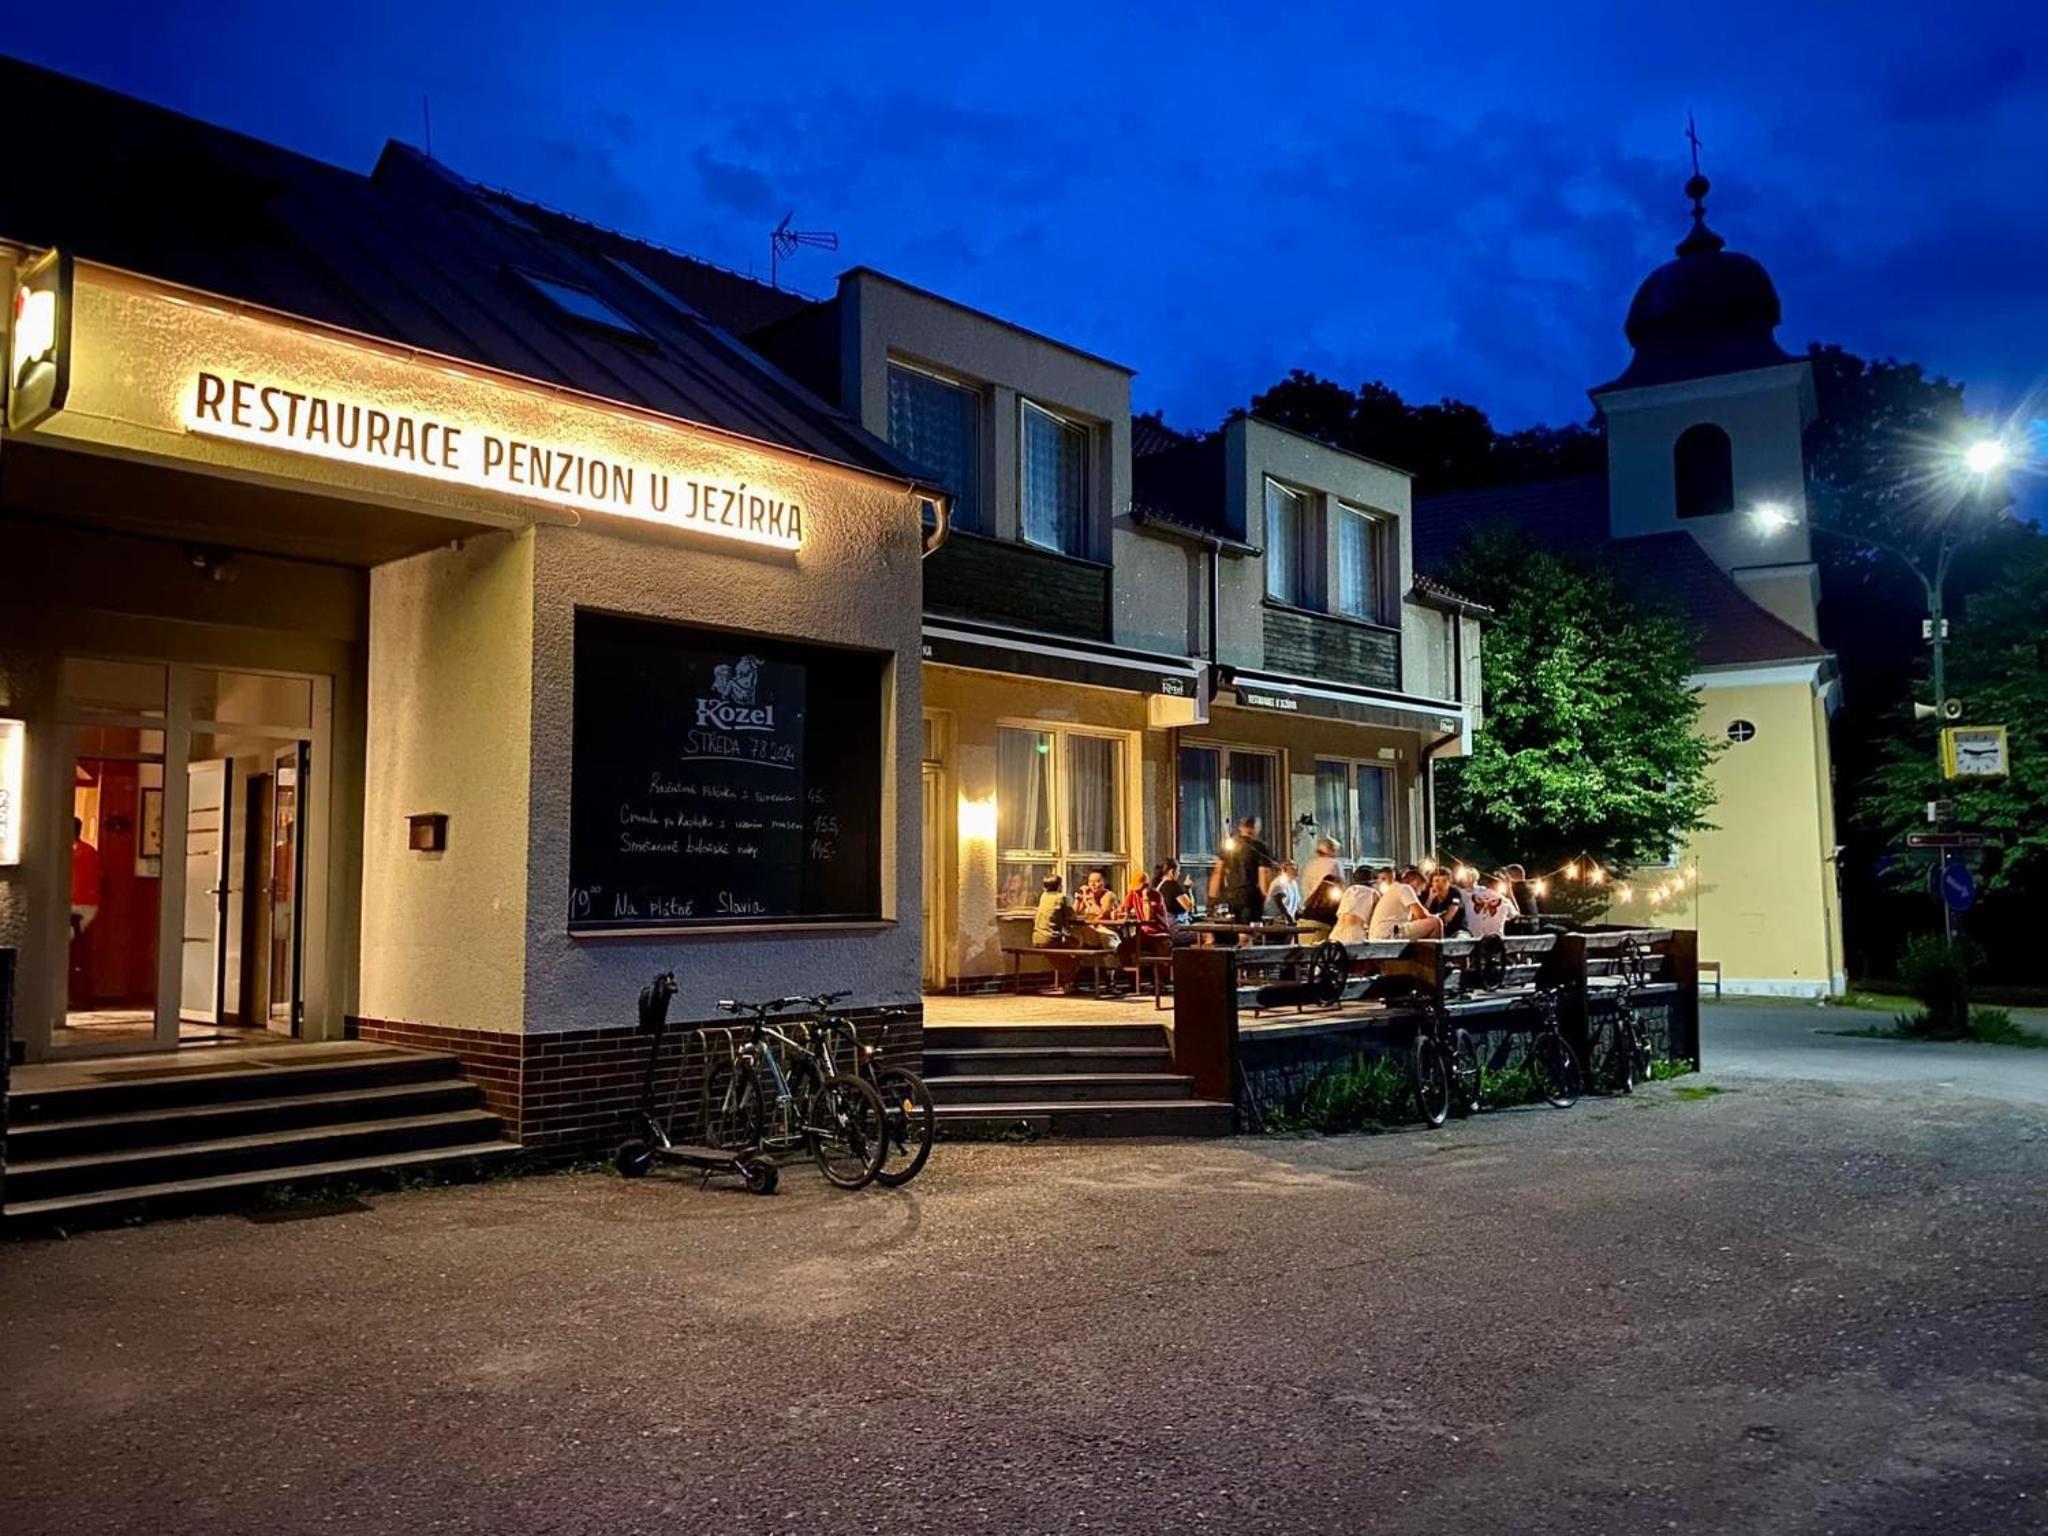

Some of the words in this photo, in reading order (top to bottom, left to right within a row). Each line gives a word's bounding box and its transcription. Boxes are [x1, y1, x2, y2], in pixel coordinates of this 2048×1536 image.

[195, 371, 462, 472] RESTAURACE
[484, 436, 635, 507] PENZION
[650, 475, 670, 513] U
[685, 480, 803, 543] JEZÍRKA
[695, 697, 777, 731] Kozel
[613, 889, 640, 918] Na
[714, 889, 766, 915] Slavia
